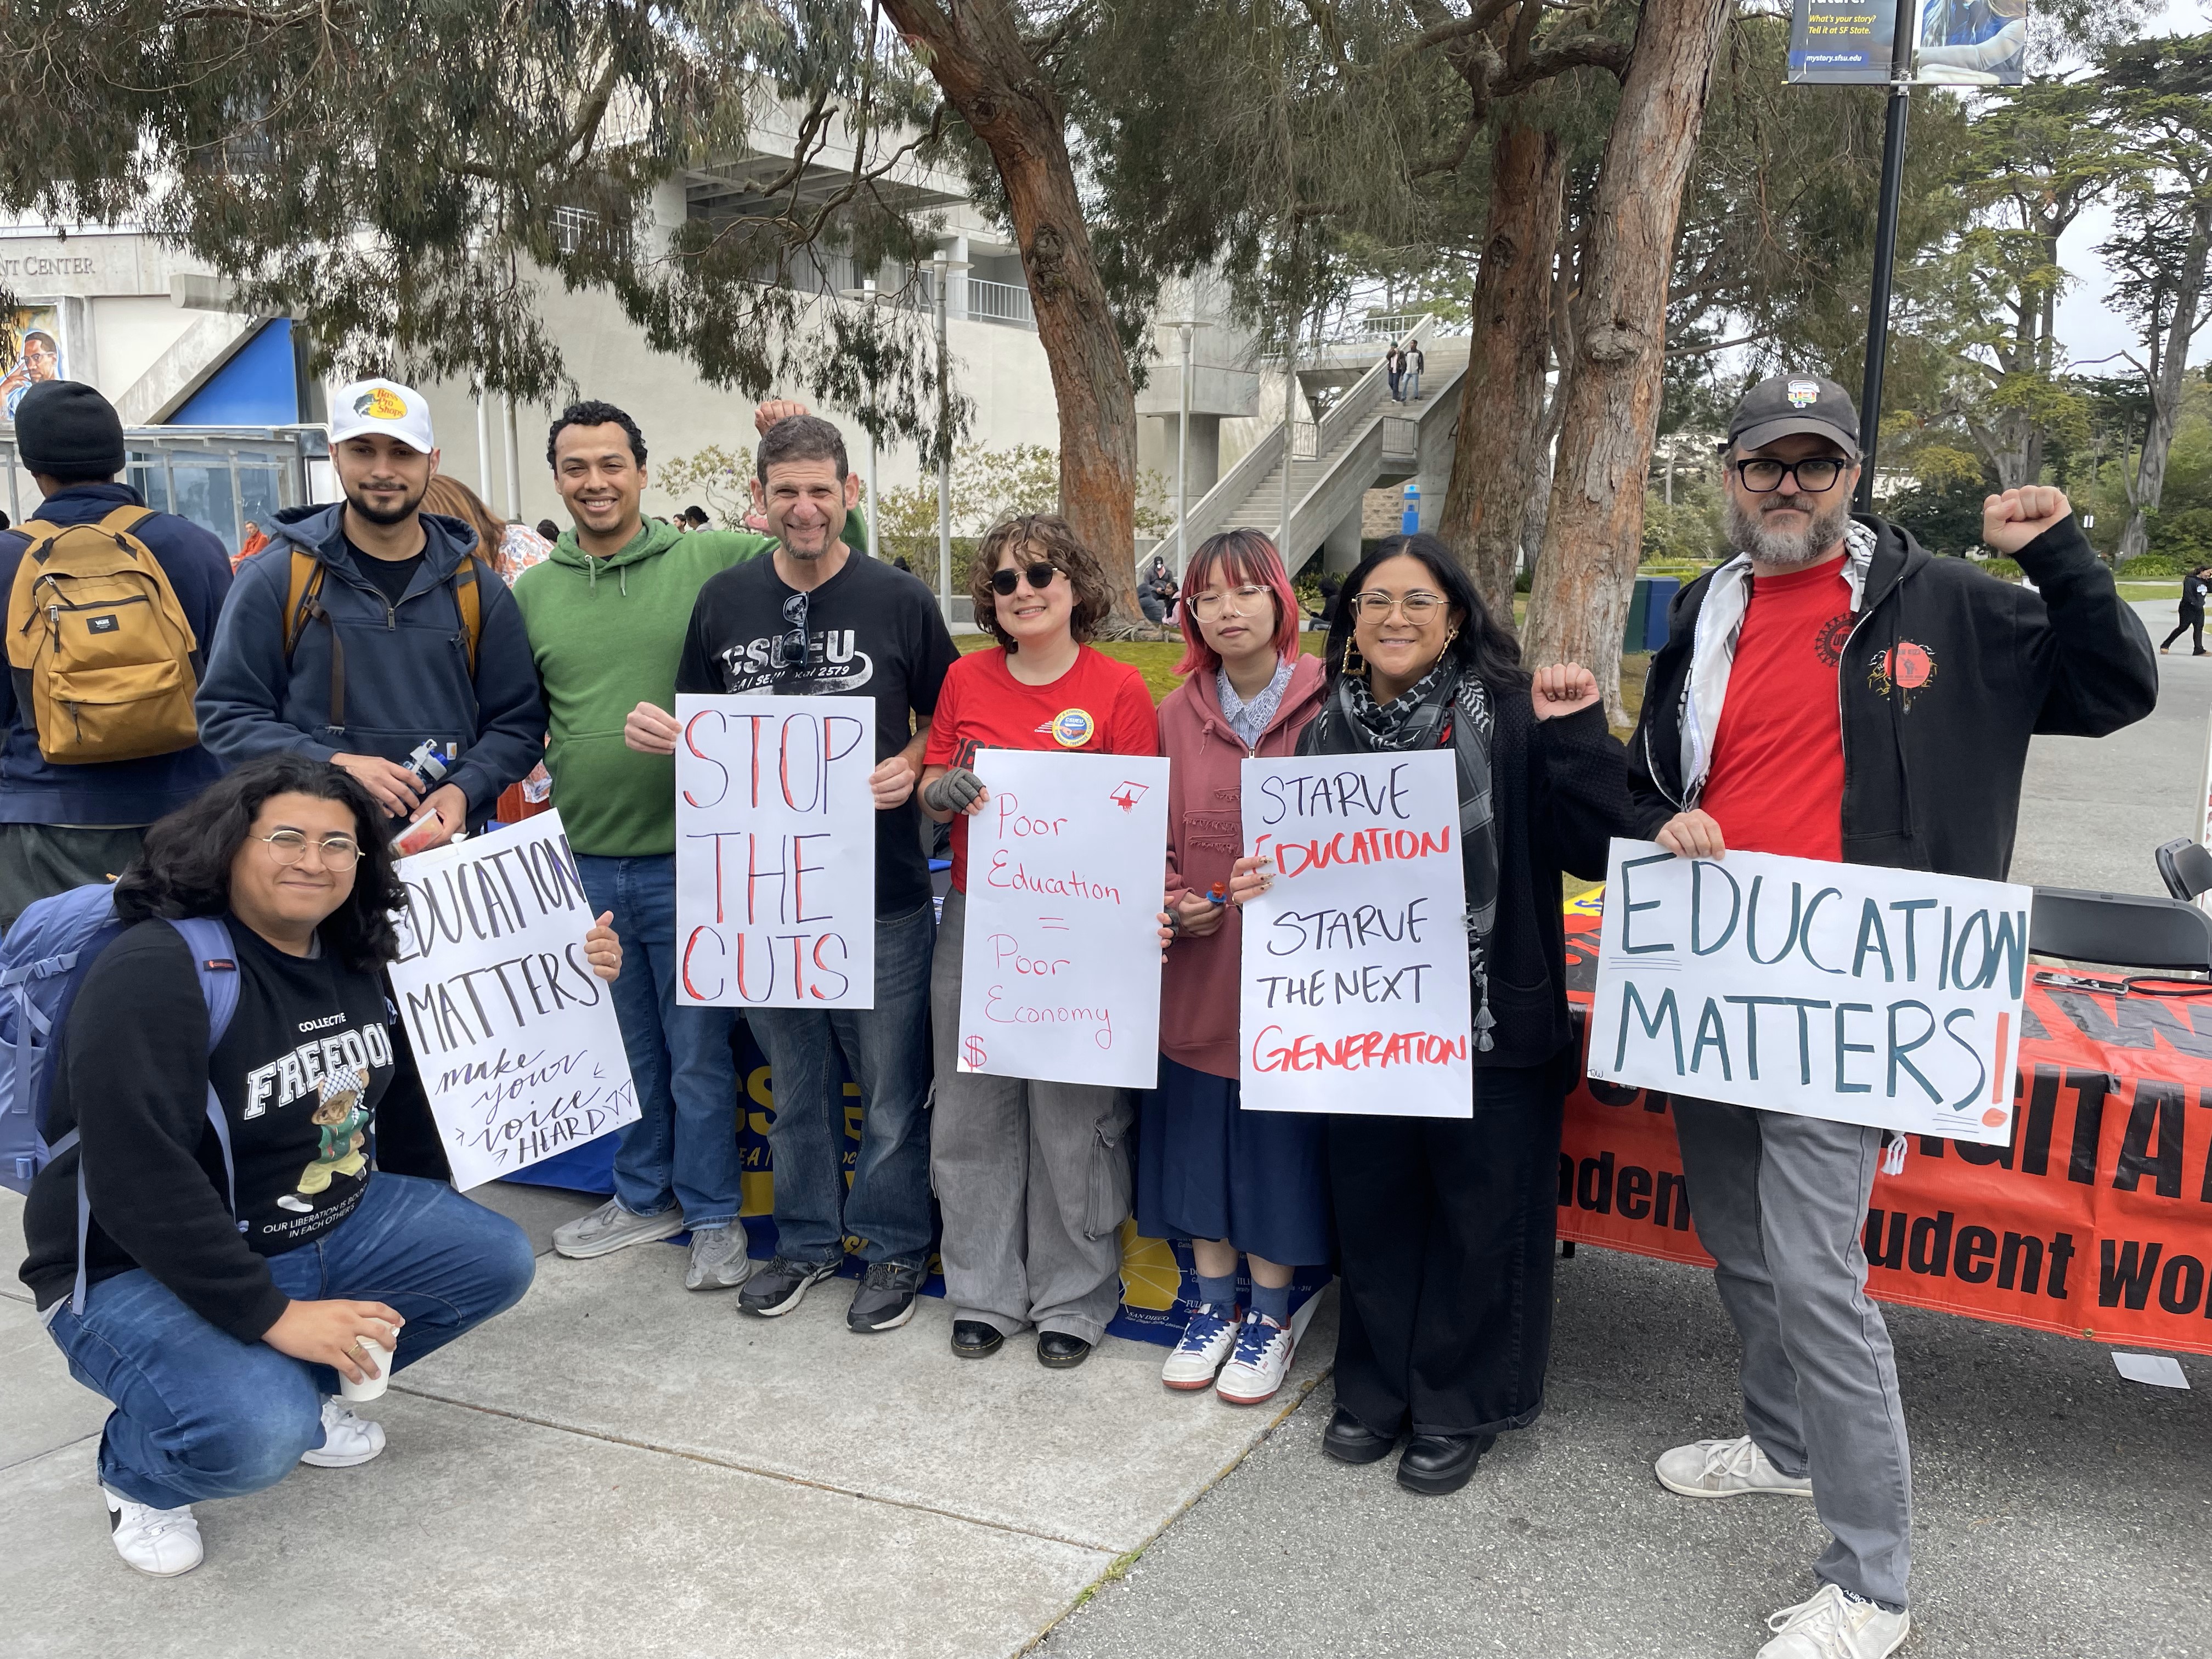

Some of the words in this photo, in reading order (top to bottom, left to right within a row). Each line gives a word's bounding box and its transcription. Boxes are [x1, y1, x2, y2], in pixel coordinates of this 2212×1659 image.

[1853, 15, 1876, 24] story?
[1806, 54, 1862, 63] mystory.sfsu.edu
[377, 405, 404, 417] Shops
[817, 665, 850, 676] 2579
[683, 709, 863, 814] STOP
[995, 792, 1068, 840] Poor
[1261, 763, 1410, 825] STARVE
[686, 832, 833, 924] THE
[988, 849, 1121, 905] Education
[1266, 897, 1429, 956] STARVE
[1621, 851, 2027, 1000] EDUCATION
[682, 925, 848, 1002] CUTS
[987, 934, 1071, 975] Poor
[405, 942, 599, 1054] MATTERS
[1256, 969, 1324, 1009] THE
[1335, 963, 1432, 1006] NEXT
[985, 985, 1111, 1050] Economy
[435, 1048, 546, 1095] make
[1252, 1025, 1467, 1073] GENERATION
[1614, 980, 2010, 1127] MATTERS!
[471, 1050, 588, 1123] your
[469, 1087, 602, 1152] voice
[263, 1221, 289, 1234] OUR
[290, 1204, 339, 1229] LIBERATION
[340, 1200, 347, 1209] IS
[289, 1231, 299, 1239] IN
[300, 1220, 324, 1235] EACH
[325, 1202, 356, 1225] OTHERS
[1867, 1207, 2075, 1301] udent
